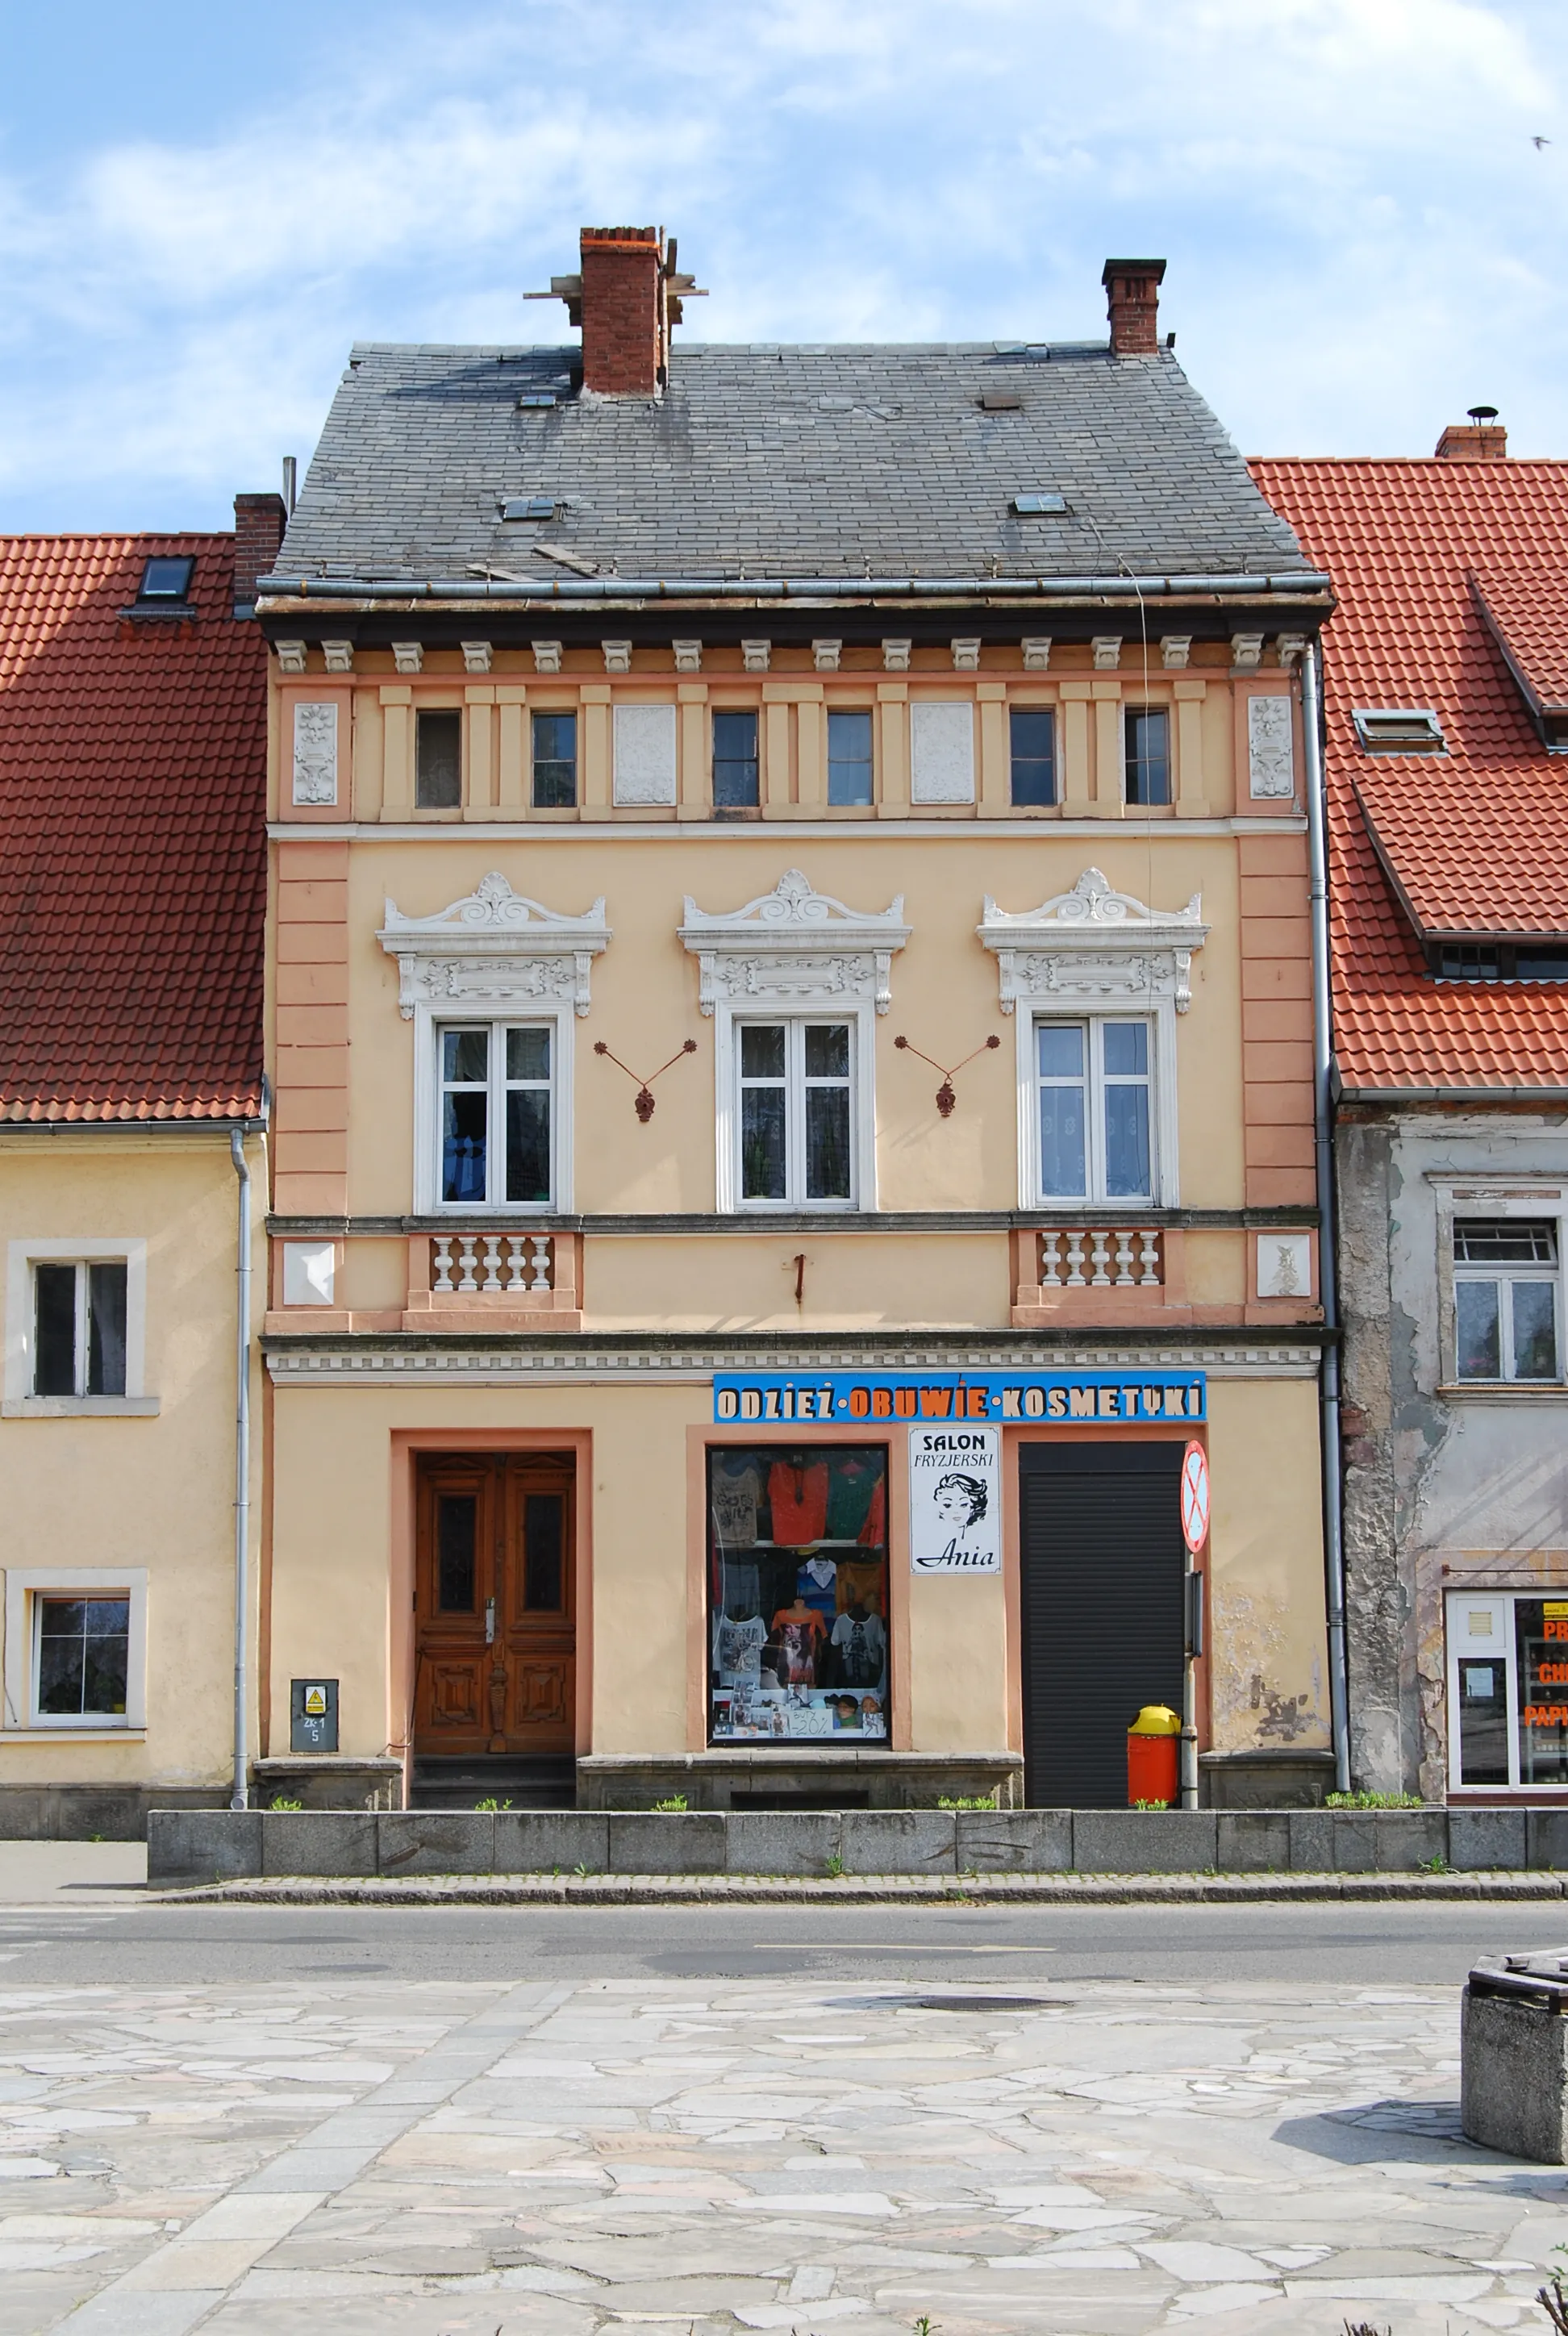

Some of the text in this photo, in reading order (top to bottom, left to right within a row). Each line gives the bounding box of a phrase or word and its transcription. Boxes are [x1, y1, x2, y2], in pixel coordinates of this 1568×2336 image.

[924, 1435, 985, 1452] SALON
[915, 1454, 993, 1466] FRYZJERSKI
[916, 1537, 995, 1567] Ania
[1539, 1662, 1568, 1684] CH
[793, 1710, 815, 1719] BUTY
[792, 1717, 828, 1735] -20%
[311, 1729, 319, 1742] 5
